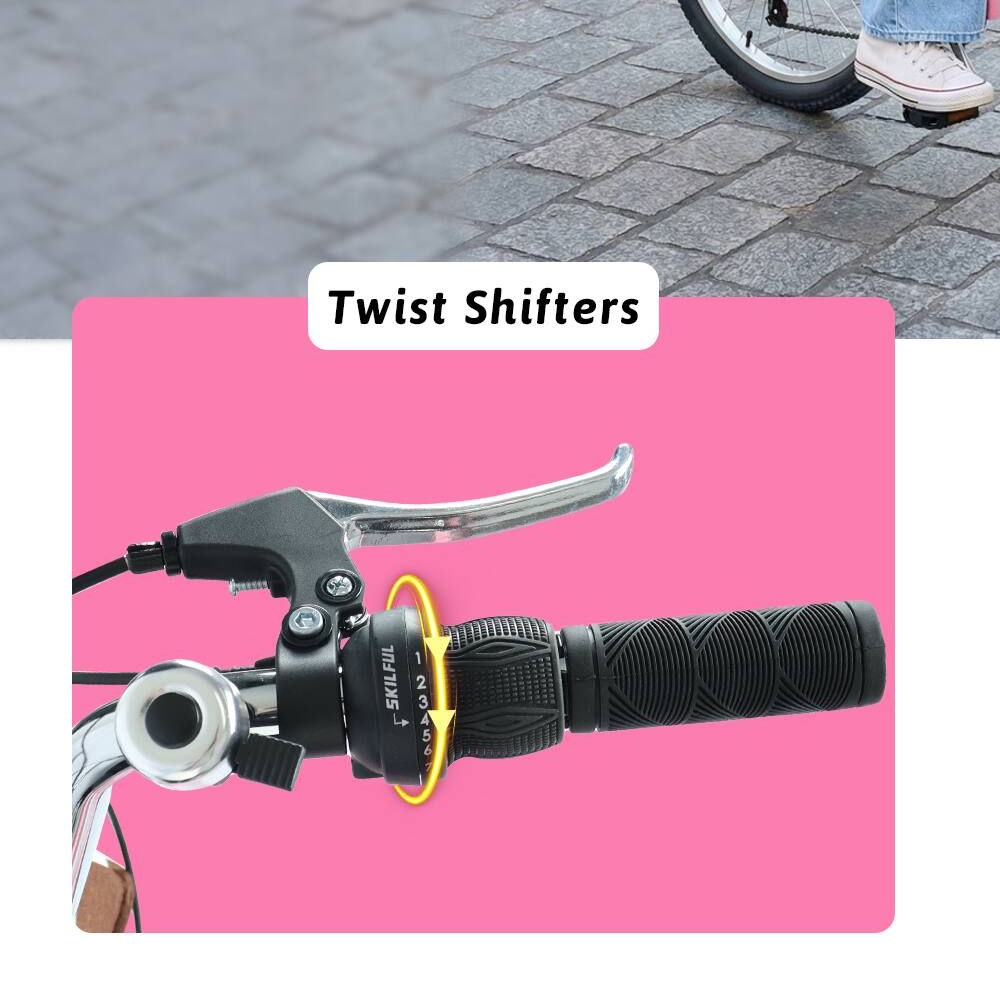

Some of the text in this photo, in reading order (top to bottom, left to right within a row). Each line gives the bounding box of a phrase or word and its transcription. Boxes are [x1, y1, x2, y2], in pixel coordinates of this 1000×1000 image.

[415, 652, 422, 665] 1
[381, 644, 400, 711] SKILFUL
[416, 675, 427, 690] 2
[418, 694, 429, 710] 3
[420, 712, 430, 727] 4
[422, 728, 431, 743] 5
[424, 744, 433, 756] 6
